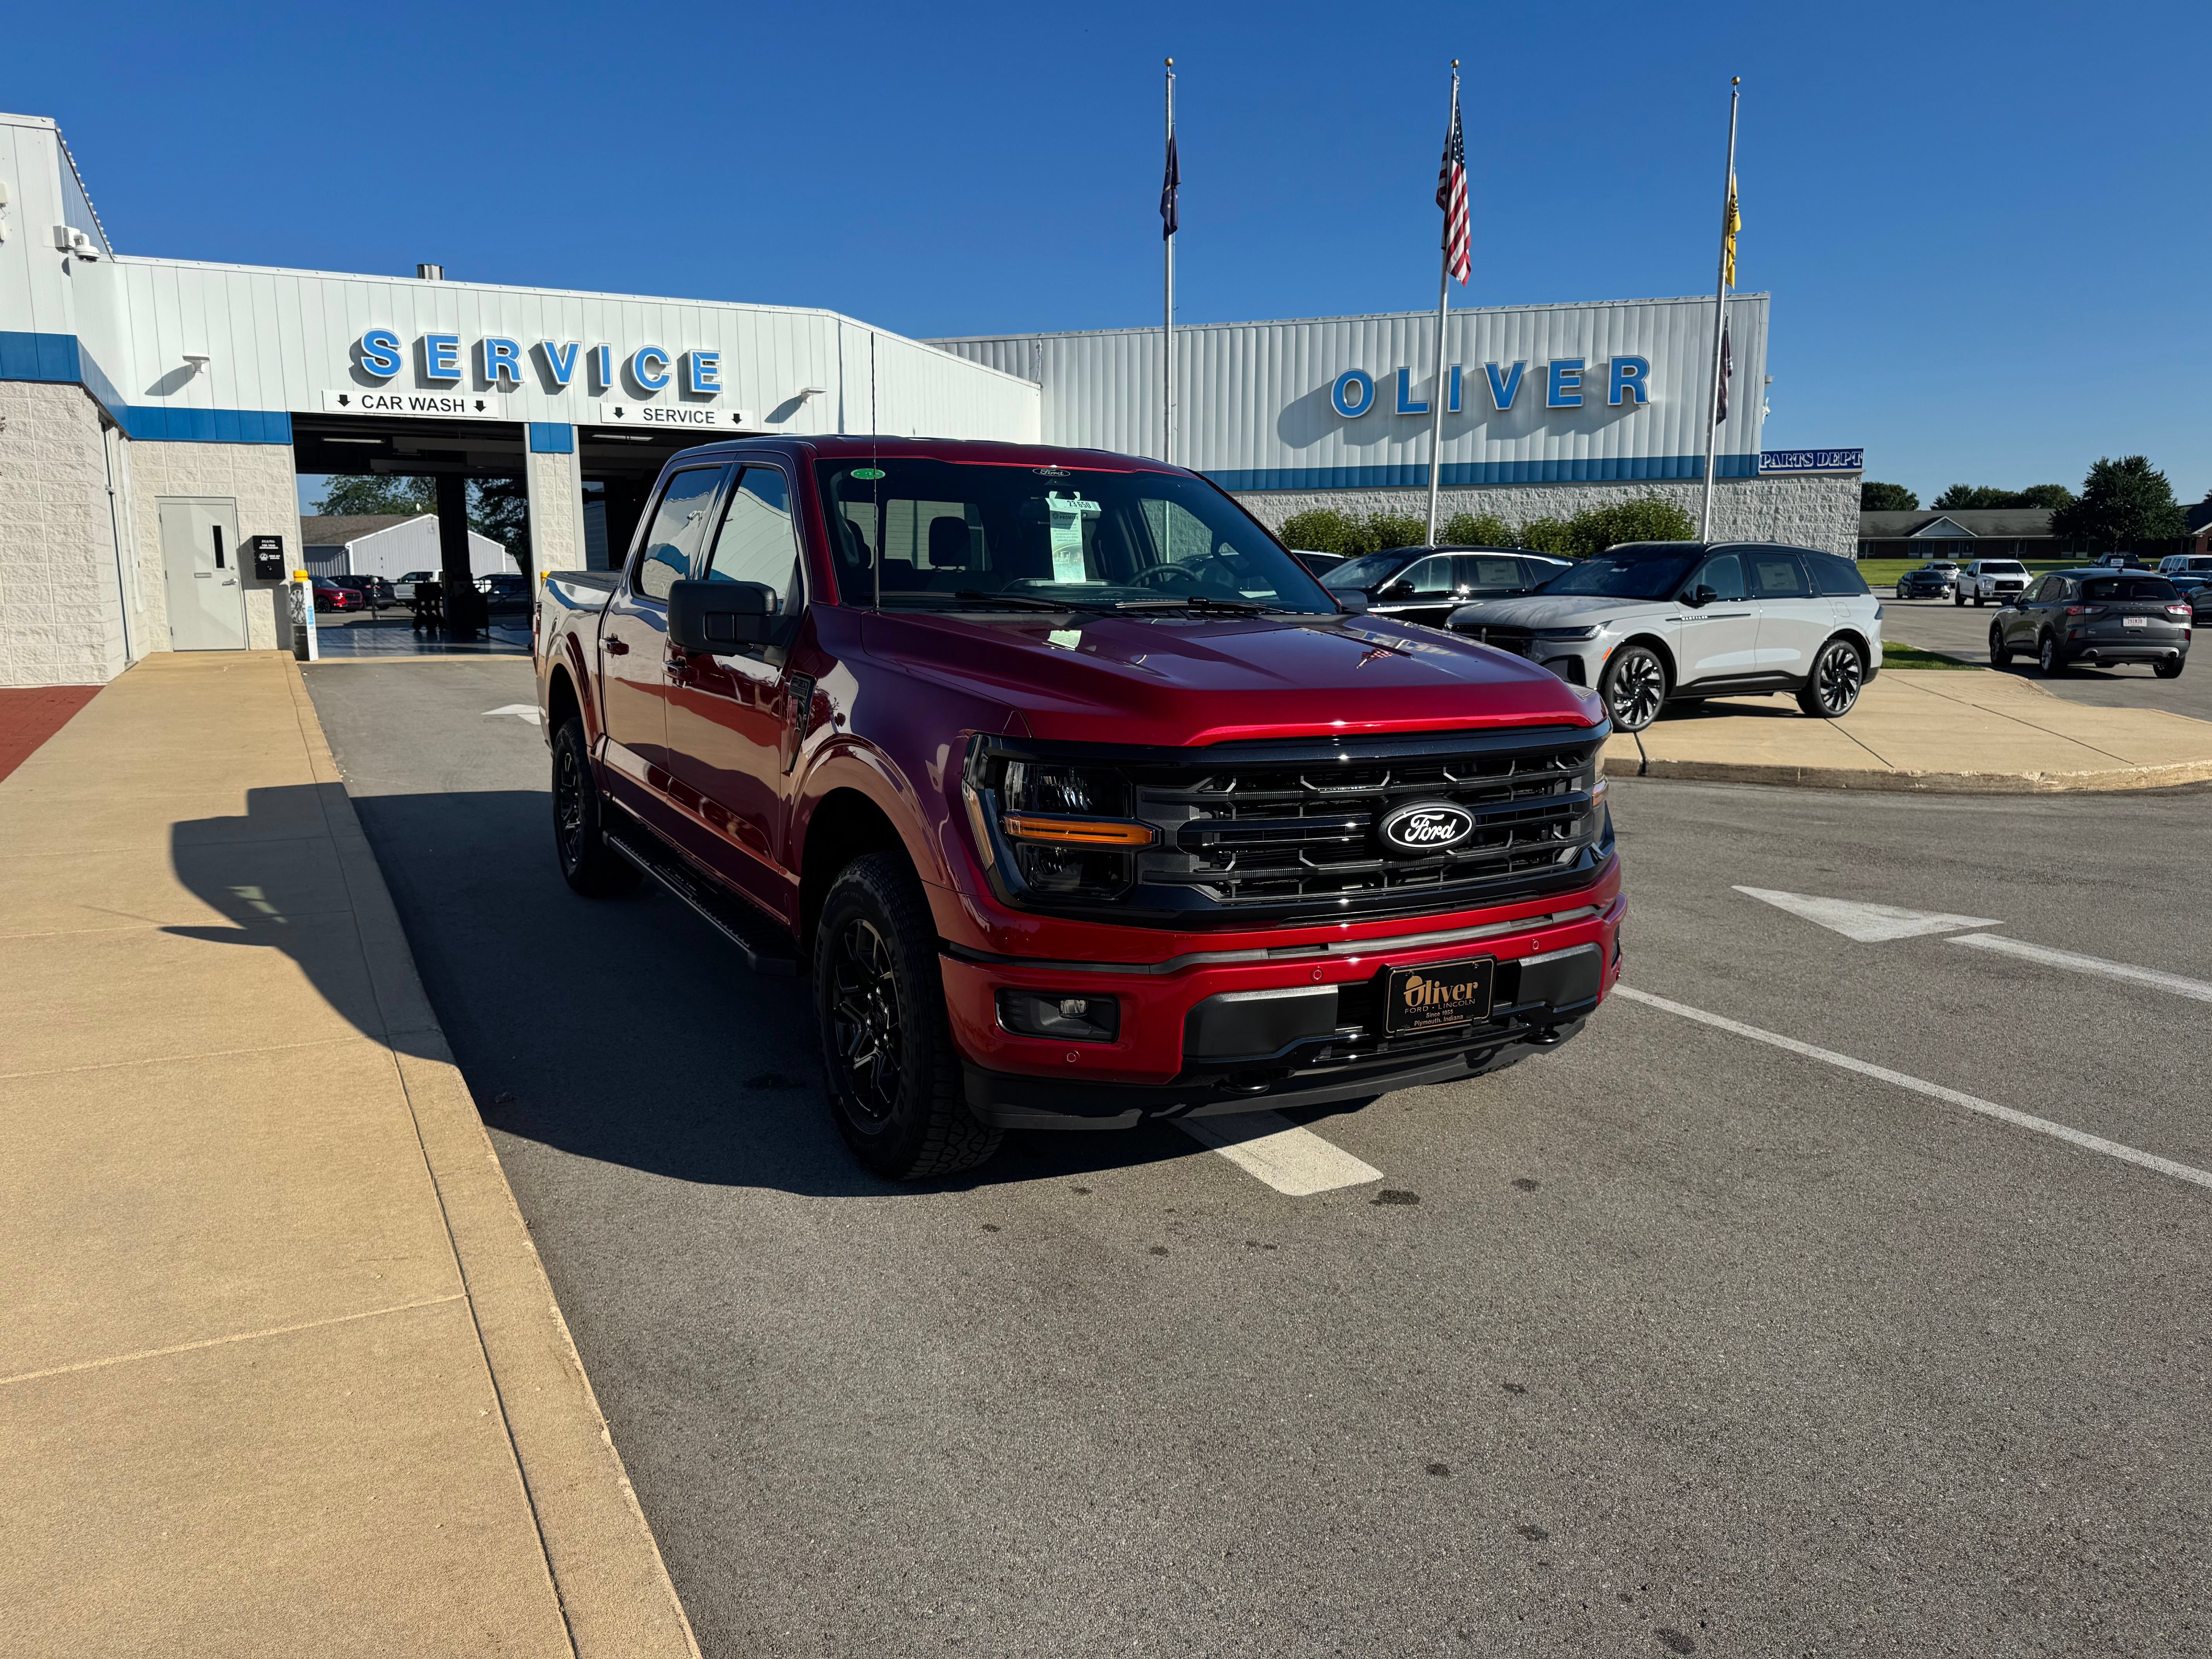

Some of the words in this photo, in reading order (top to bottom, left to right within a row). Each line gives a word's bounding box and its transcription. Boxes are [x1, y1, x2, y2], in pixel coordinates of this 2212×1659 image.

[361, 328, 723, 394] SERVICE
[1331, 355, 1650, 418] OLIVER
[361, 395, 403, 410] CAR
[408, 397, 465, 412] WASH
[643, 408, 716, 424] SERVICE
[1760, 453, 1814, 468] PARTS
[1817, 451, 1862, 467] DEPT
[1405, 814, 1457, 842] Ford
[1404, 975, 1479, 1007] Oliver
[1438, 999, 1475, 1009] LINCOLN
